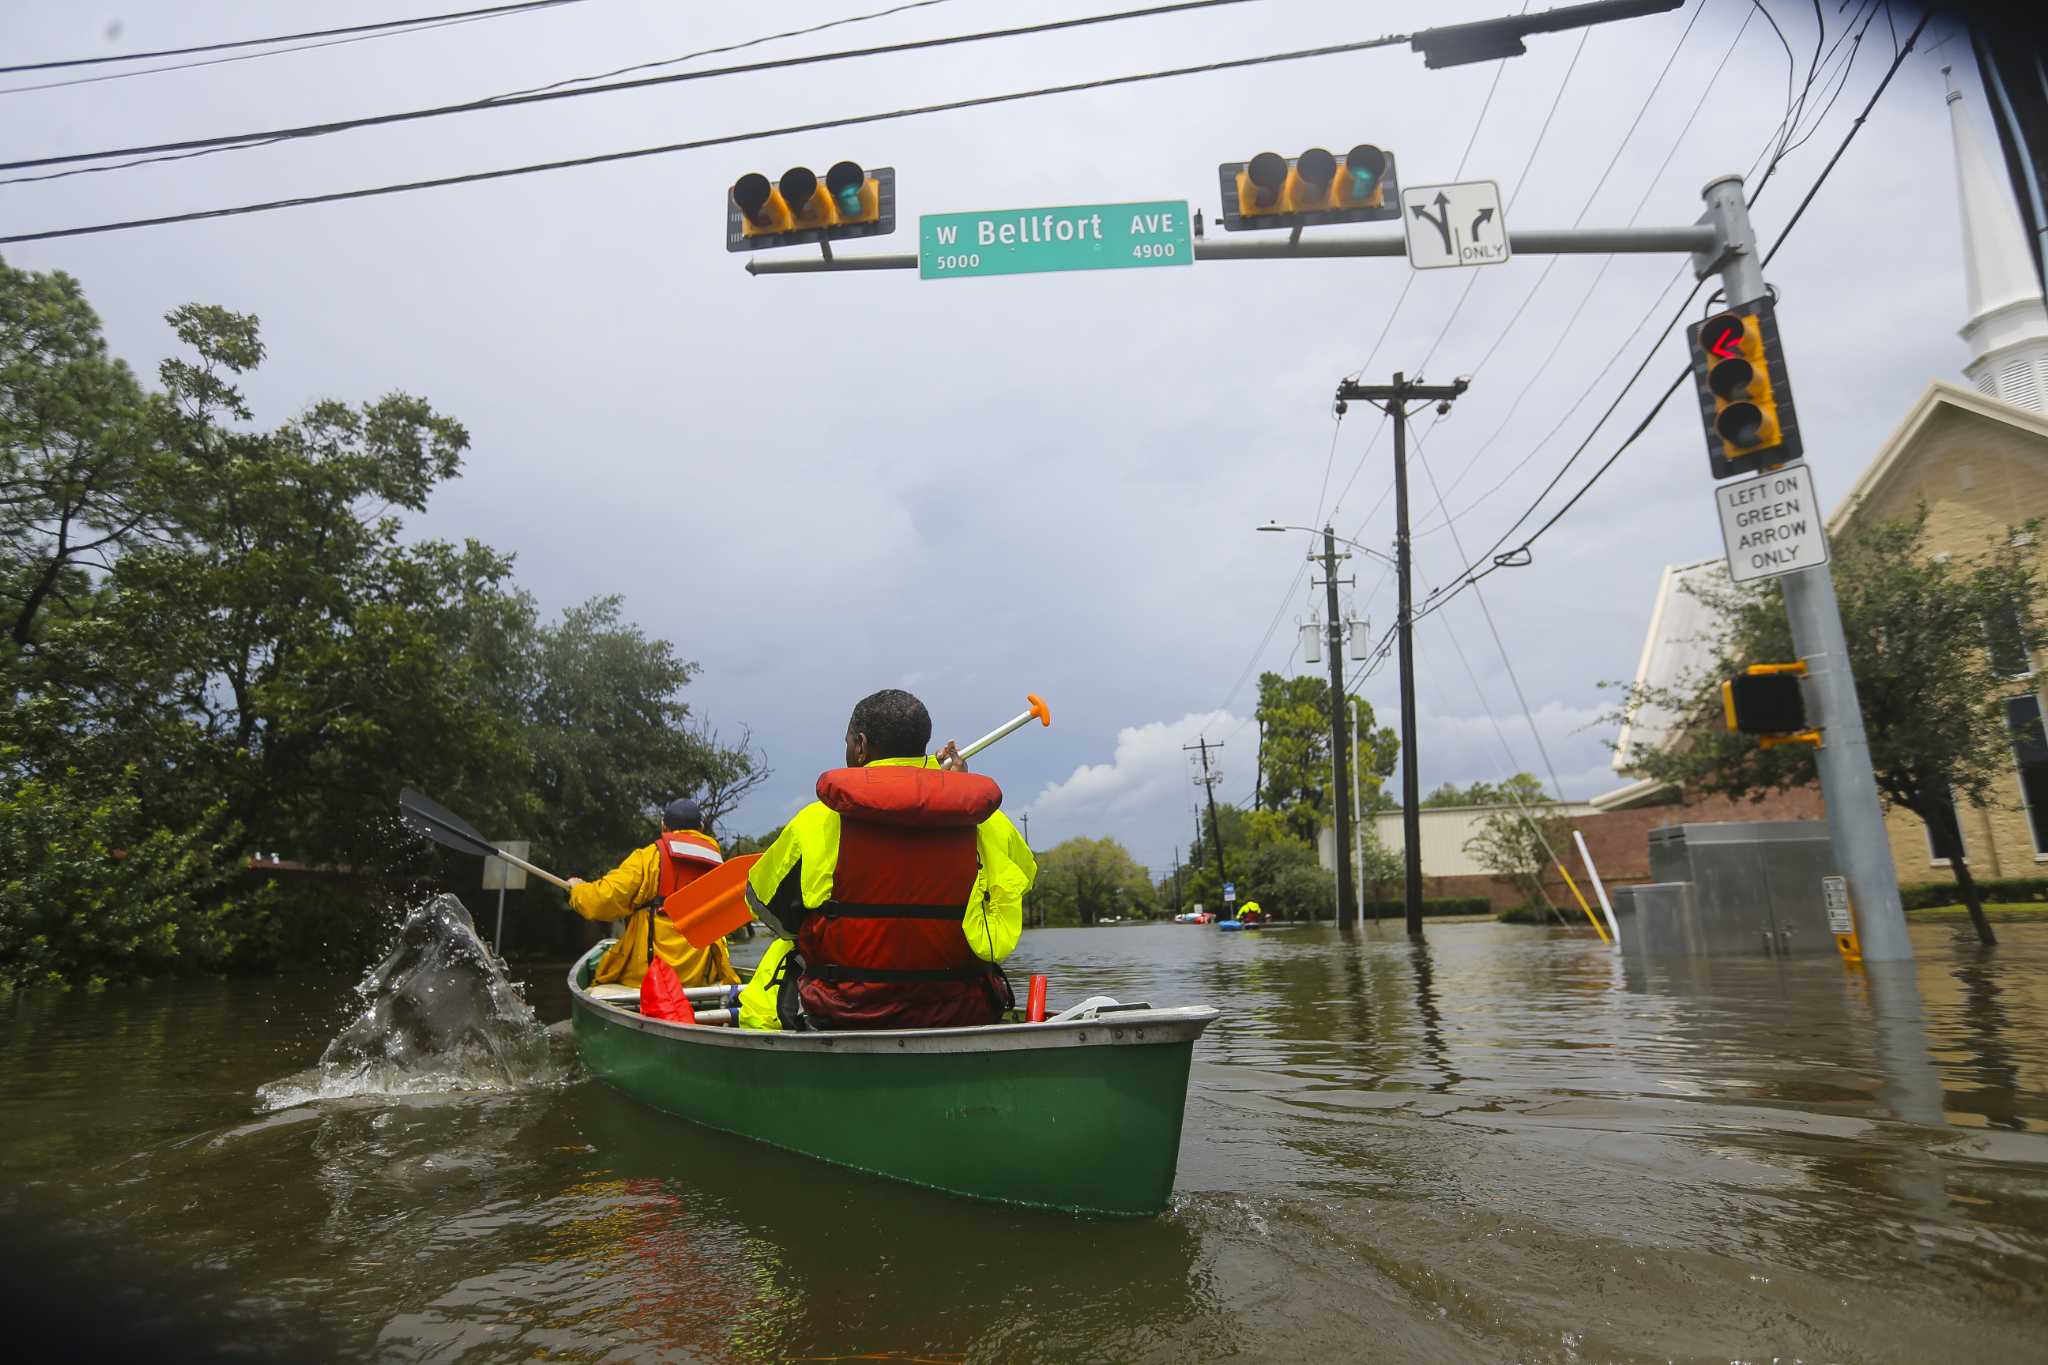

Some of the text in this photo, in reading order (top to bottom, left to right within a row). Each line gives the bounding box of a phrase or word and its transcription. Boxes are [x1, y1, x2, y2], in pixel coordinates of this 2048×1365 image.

[936, 214, 1174, 246] W Bellfort AVE
[936, 254, 980, 270] 5000
[1132, 243, 1176, 259] 4900
[1462, 243, 1504, 260] ONLY
[1728, 476, 1798, 507] LEFT ON
[1735, 499, 1801, 528] GREEN
[1738, 520, 1807, 550] ARROW
[1751, 544, 1800, 569] ONLY
